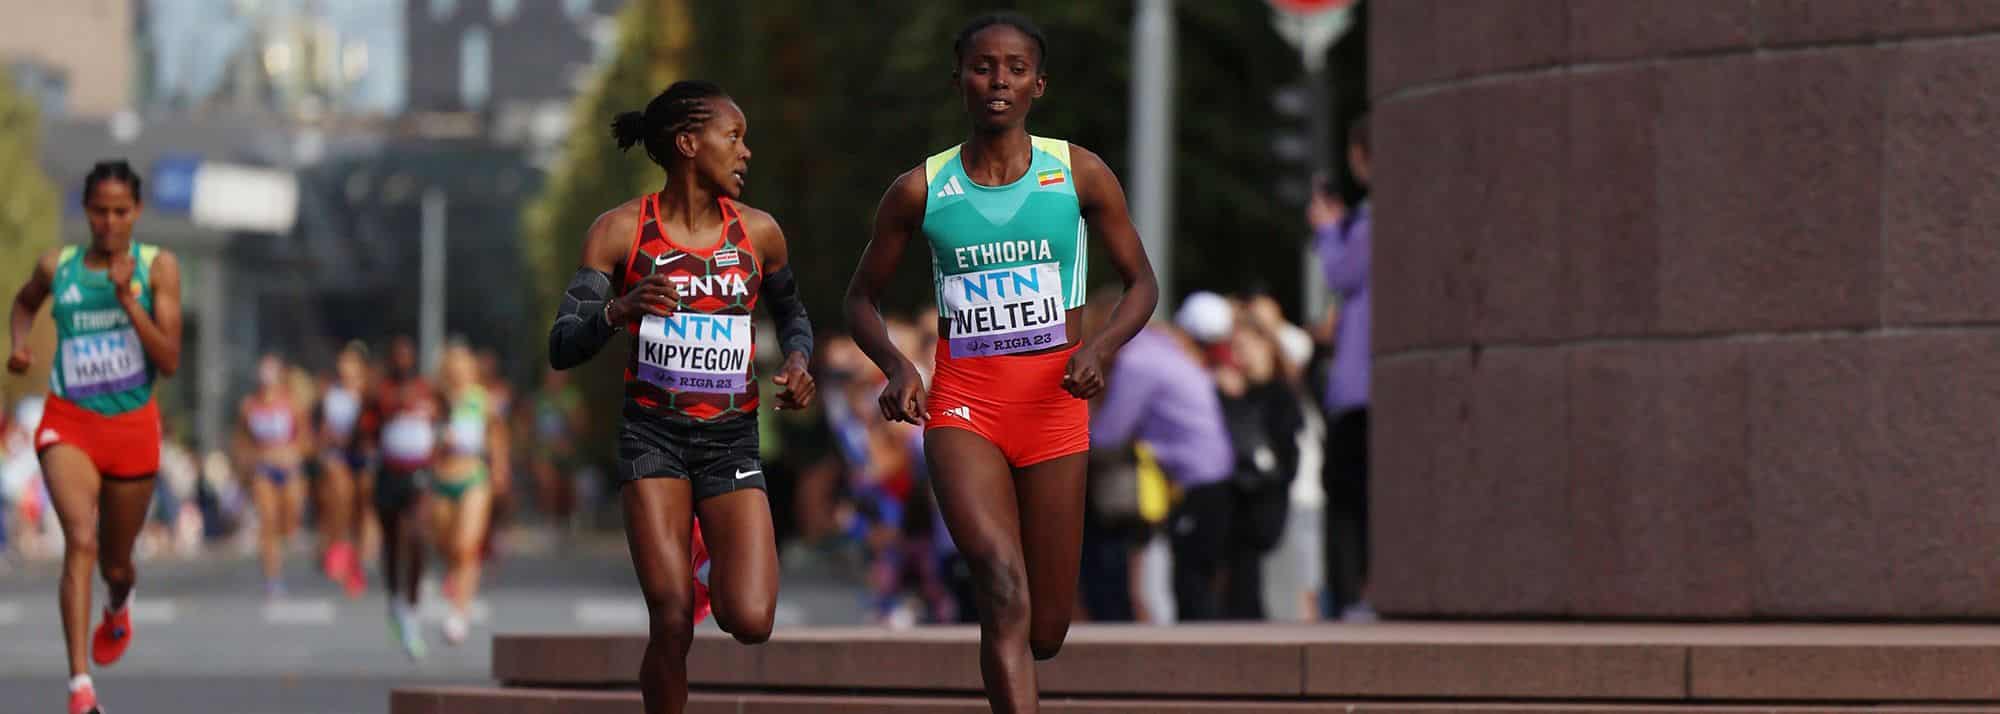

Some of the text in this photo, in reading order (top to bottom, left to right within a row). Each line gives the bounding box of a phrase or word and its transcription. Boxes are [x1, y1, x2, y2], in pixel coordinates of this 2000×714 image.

[955, 239, 1052, 268] ETHIOPIA
[668, 273, 748, 297] ENYA
[964, 267, 1039, 302] NTN
[664, 315, 733, 341] NTN
[955, 297, 1058, 335] WELTEJI
[72, 334, 126, 356] NTN
[994, 333, 1052, 350] RIGA 23
[75, 353, 131, 377] HAILU
[644, 341, 744, 371] KIPYEGON
[680, 377, 731, 388] RIGA 23
